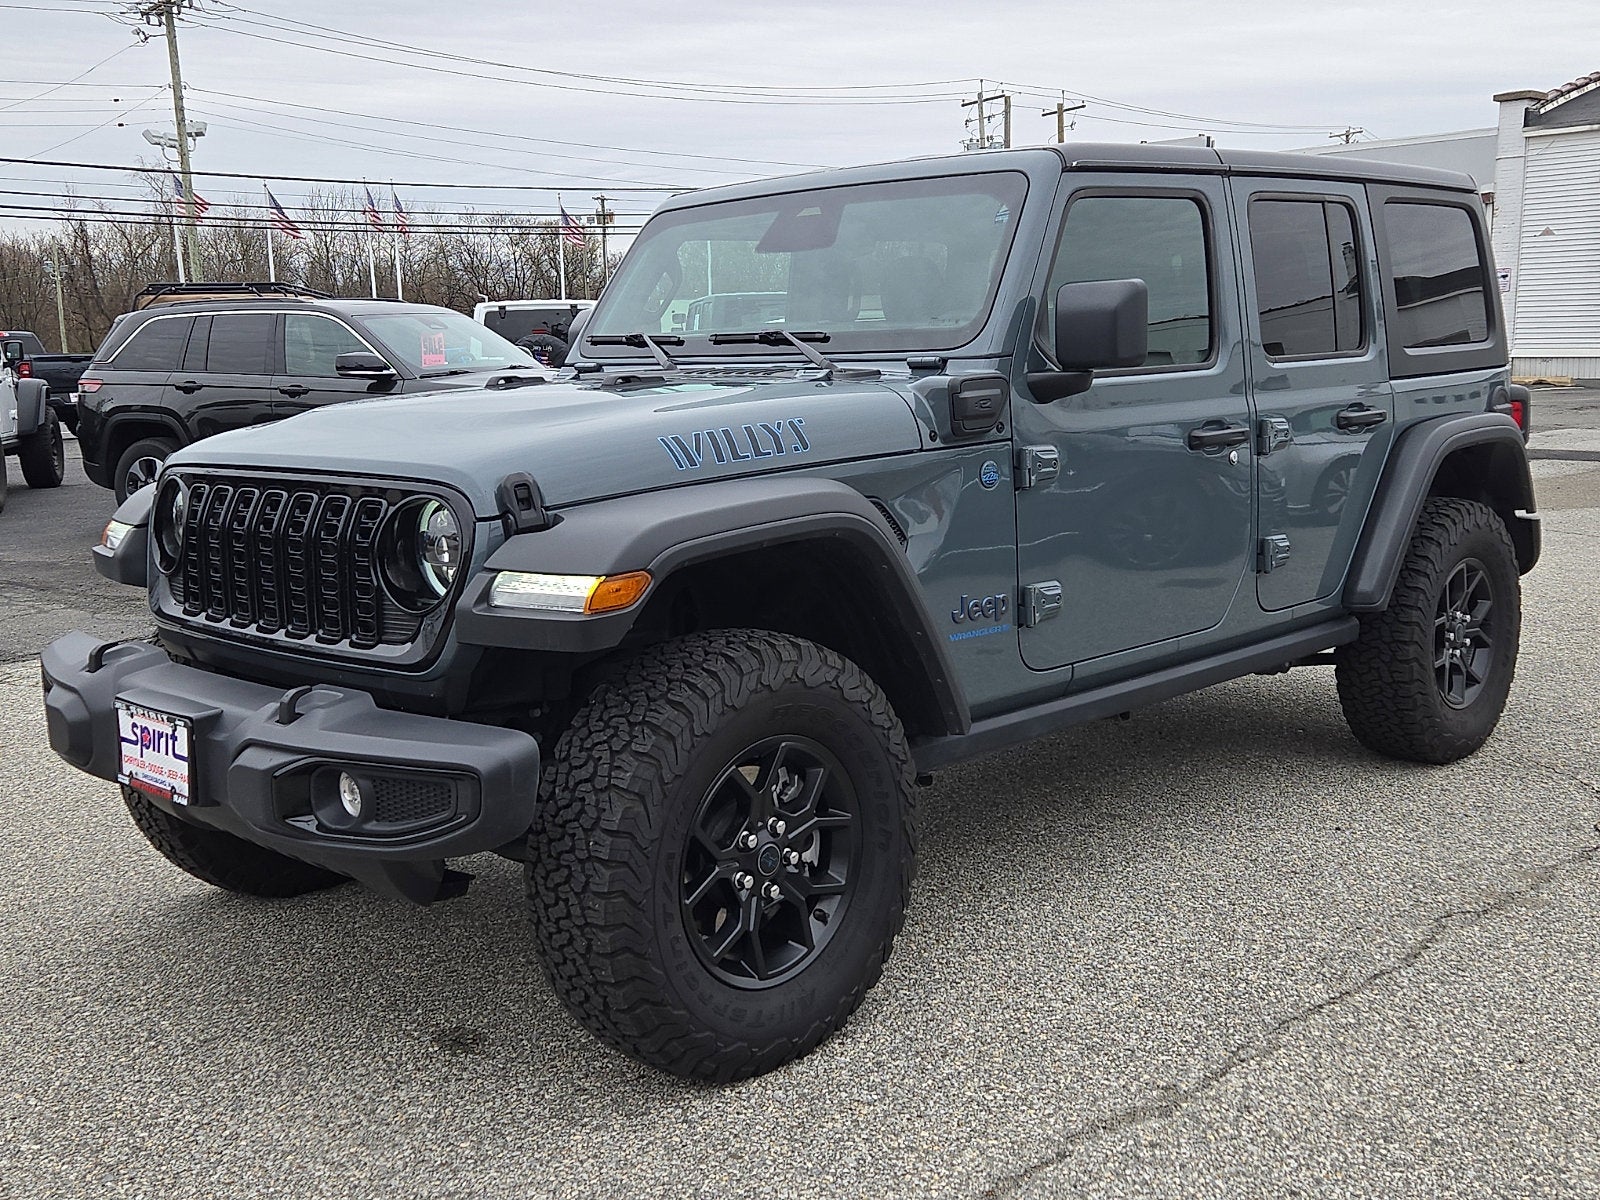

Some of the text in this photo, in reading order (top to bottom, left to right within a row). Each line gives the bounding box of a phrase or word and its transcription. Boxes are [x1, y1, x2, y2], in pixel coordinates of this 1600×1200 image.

[423, 336, 445, 356] SALE
[658, 418, 810, 470] WILLYS
[951, 593, 1009, 624] Jeep
[949, 625, 1002, 641] WRANGLER
